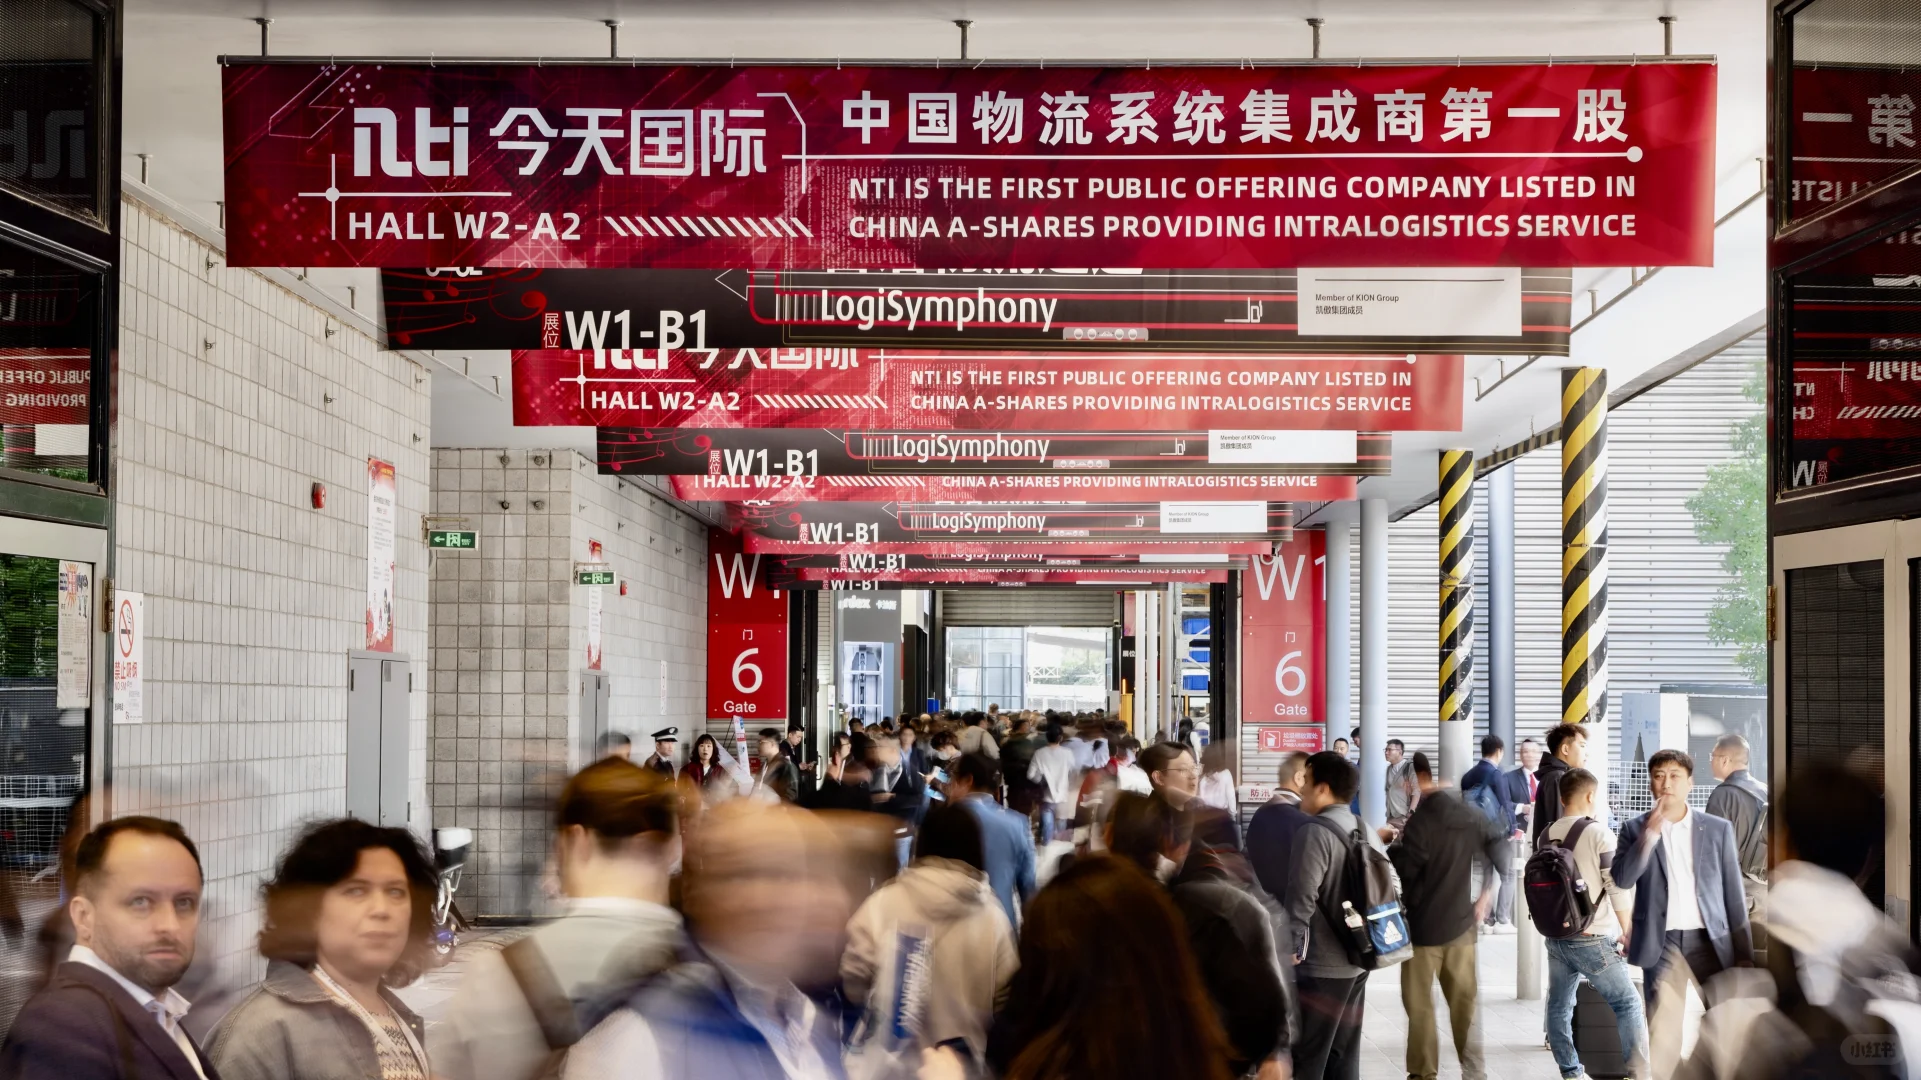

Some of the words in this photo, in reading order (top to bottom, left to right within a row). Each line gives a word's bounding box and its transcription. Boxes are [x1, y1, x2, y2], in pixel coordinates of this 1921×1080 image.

[842, 87, 1629, 146] 中国物流系统集成商第一股
[489, 107, 767, 177] 今天国际
[849, 178, 895, 200] NTI
[905, 178, 928, 200] IS
[937, 178, 992, 200] THE
[1001, 178, 1079, 200] FIRST
[1088, 178, 1187, 200] PUBLIC
[1195, 178, 1337, 199] OFFERING
[1346, 176, 1492, 199] COMPANY
[1500, 176, 1596, 199] LISTED
[1606, 176, 1635, 199] IN
[349, 212, 445, 240] HALL
[454, 211, 582, 240] W2-A2
[849, 216, 941, 239] CHINA
[948, 216, 1095, 239] A-SHARES
[1103, 215, 1266, 238] PROVIDING
[1274, 214, 1510, 237] INTRALOGISTICS
[1517, 214, 1636, 237] SERVICE
[820, 287, 1058, 331] LogiSymphony
[1315, 294, 1345, 302] Member
[1347, 294, 1355, 302] of
[1356, 294, 1375, 302] KION
[1376, 294, 1400, 304] Group
[1315, 305, 1363, 315] 凯傲集团成员
[543, 312, 560, 349] 展位
[565, 309, 708, 350] W1-B1
[911, 370, 940, 386] NTI
[946, 370, 963, 386] IS
[968, 370, 1002, 386] THE
[1008, 370, 1058, 386] FIRST
[1063, 370, 1126, 386] PUBLIC
[1131, 370, 1222, 386] OFFERING
[1227, 371, 1320, 387] COMPANY
[1325, 371, 1387, 387] LISTED
[1392, 372, 1411, 387] IN
[591, 391, 653, 410] HALL
[658, 391, 740, 411] W2-A2
[911, 395, 969, 410] CHINA
[973, 395, 1068, 411] A-SHARES
[1072, 395, 1176, 411] PROVIDING
[1181, 396, 1331, 412] INTRALOGISTICS
[1335, 396, 1411, 412] SERVICE
[893, 432, 1050, 463] LogiSymphony
[709, 450, 722, 475] 展位
[724, 448, 818, 477] W1-B1
[703, 475, 751, 489] HALL
[754, 475, 815, 489] W2-A2
[942, 476, 987, 488] CHINA
[989, 476, 1060, 488] A-SHARES
[1063, 476, 1142, 488] PROVIDING
[1144, 476, 1258, 488] INTRALOGISTICS
[1260, 476, 1318, 488] SERVICE
[810, 522, 879, 543] W1-B1
[932, 511, 1046, 533] LogiSymphony
[849, 554, 906, 570] W1-B1
[714, 553, 780, 599] W
[742, 629, 753, 641] 门
[1285, 631, 1296, 643] 门
[731, 647, 763, 694] 6
[1275, 650, 1307, 697] 6
[723, 700, 757, 713] Gate
[1274, 703, 1308, 716] Gate
